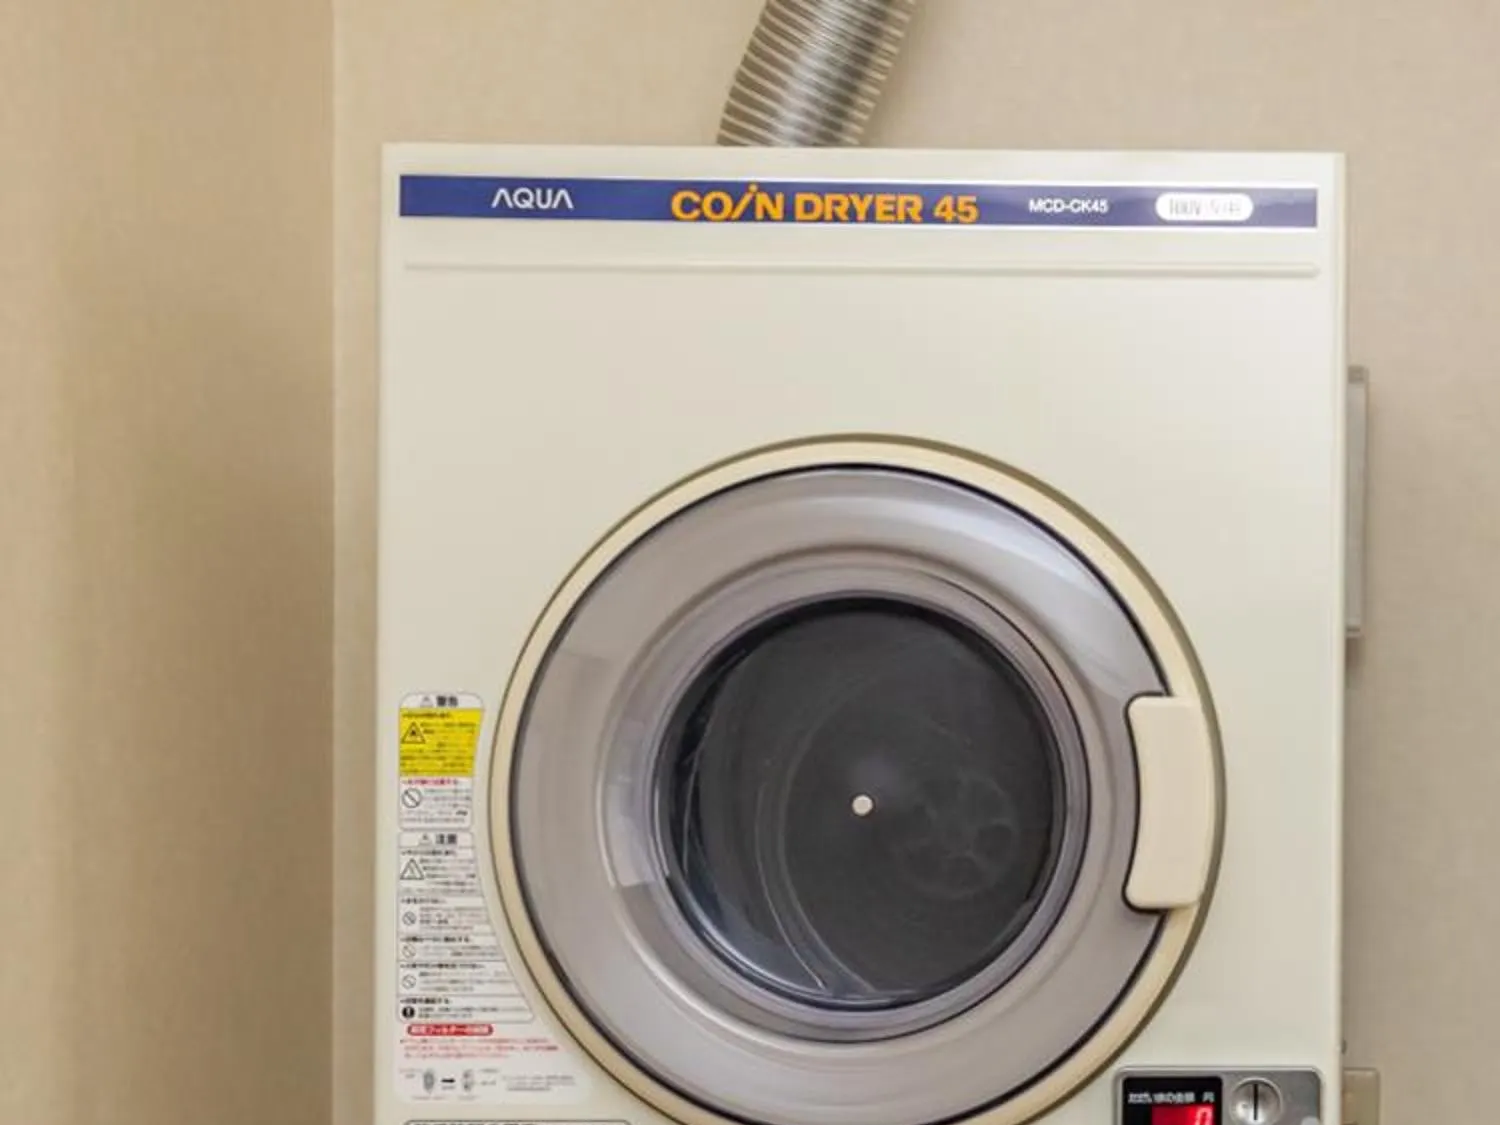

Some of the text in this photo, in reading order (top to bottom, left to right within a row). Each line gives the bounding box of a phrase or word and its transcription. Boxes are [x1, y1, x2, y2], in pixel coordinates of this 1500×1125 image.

[492, 187, 573, 209] AQUA
[795, 194, 923, 222] DRYER
[934, 195, 978, 223] 45
[1027, 198, 1109, 213] MCD-CK45
